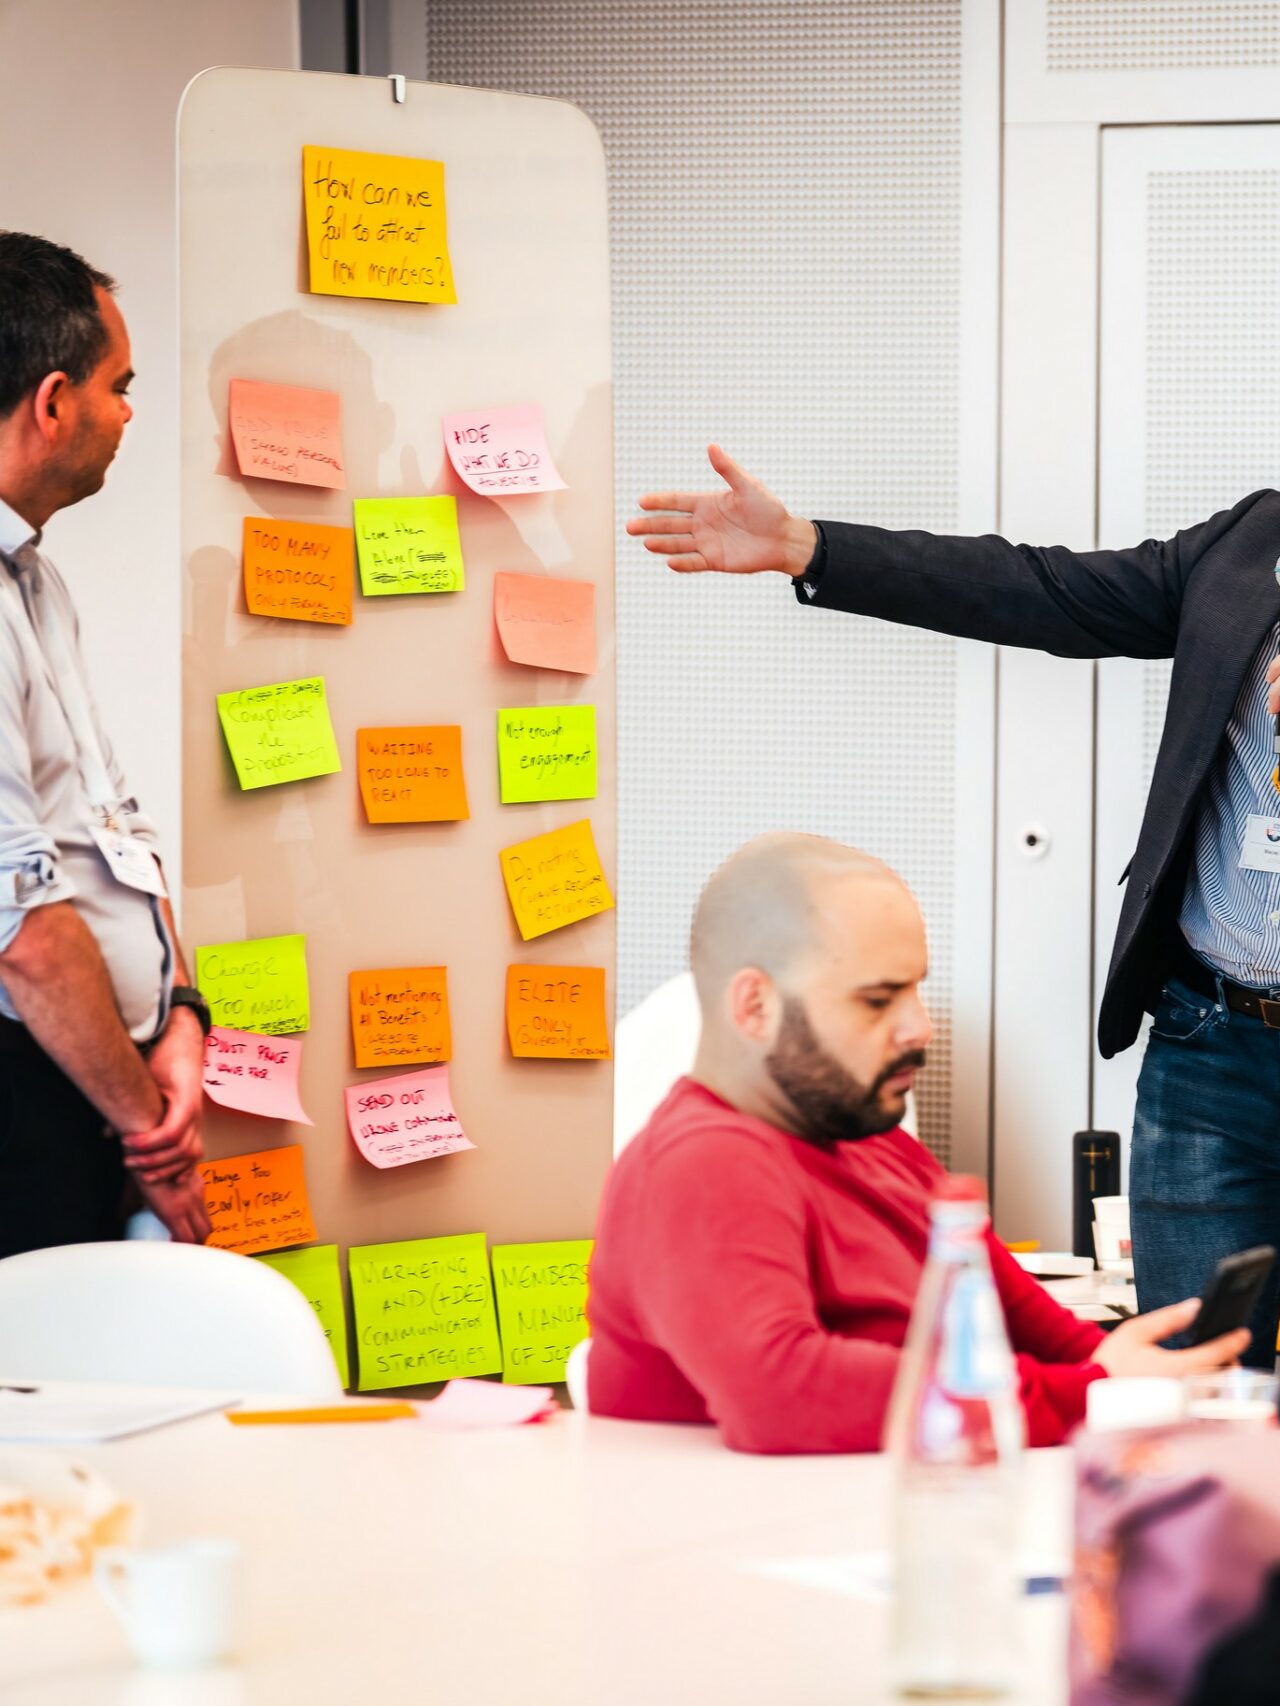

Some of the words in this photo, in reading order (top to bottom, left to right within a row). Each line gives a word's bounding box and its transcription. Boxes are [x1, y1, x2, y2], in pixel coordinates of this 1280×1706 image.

[313, 160, 355, 200] How
[406, 190, 432, 208] we
[319, 204, 347, 260] fail
[352, 213, 369, 242] to
[376, 217, 426, 245] attract
[252, 529, 280, 552] TOO
[255, 565, 336, 592] PROTOCOLS
[518, 978, 582, 1003] ELITE
[517, 1304, 588, 1336] MANUA
